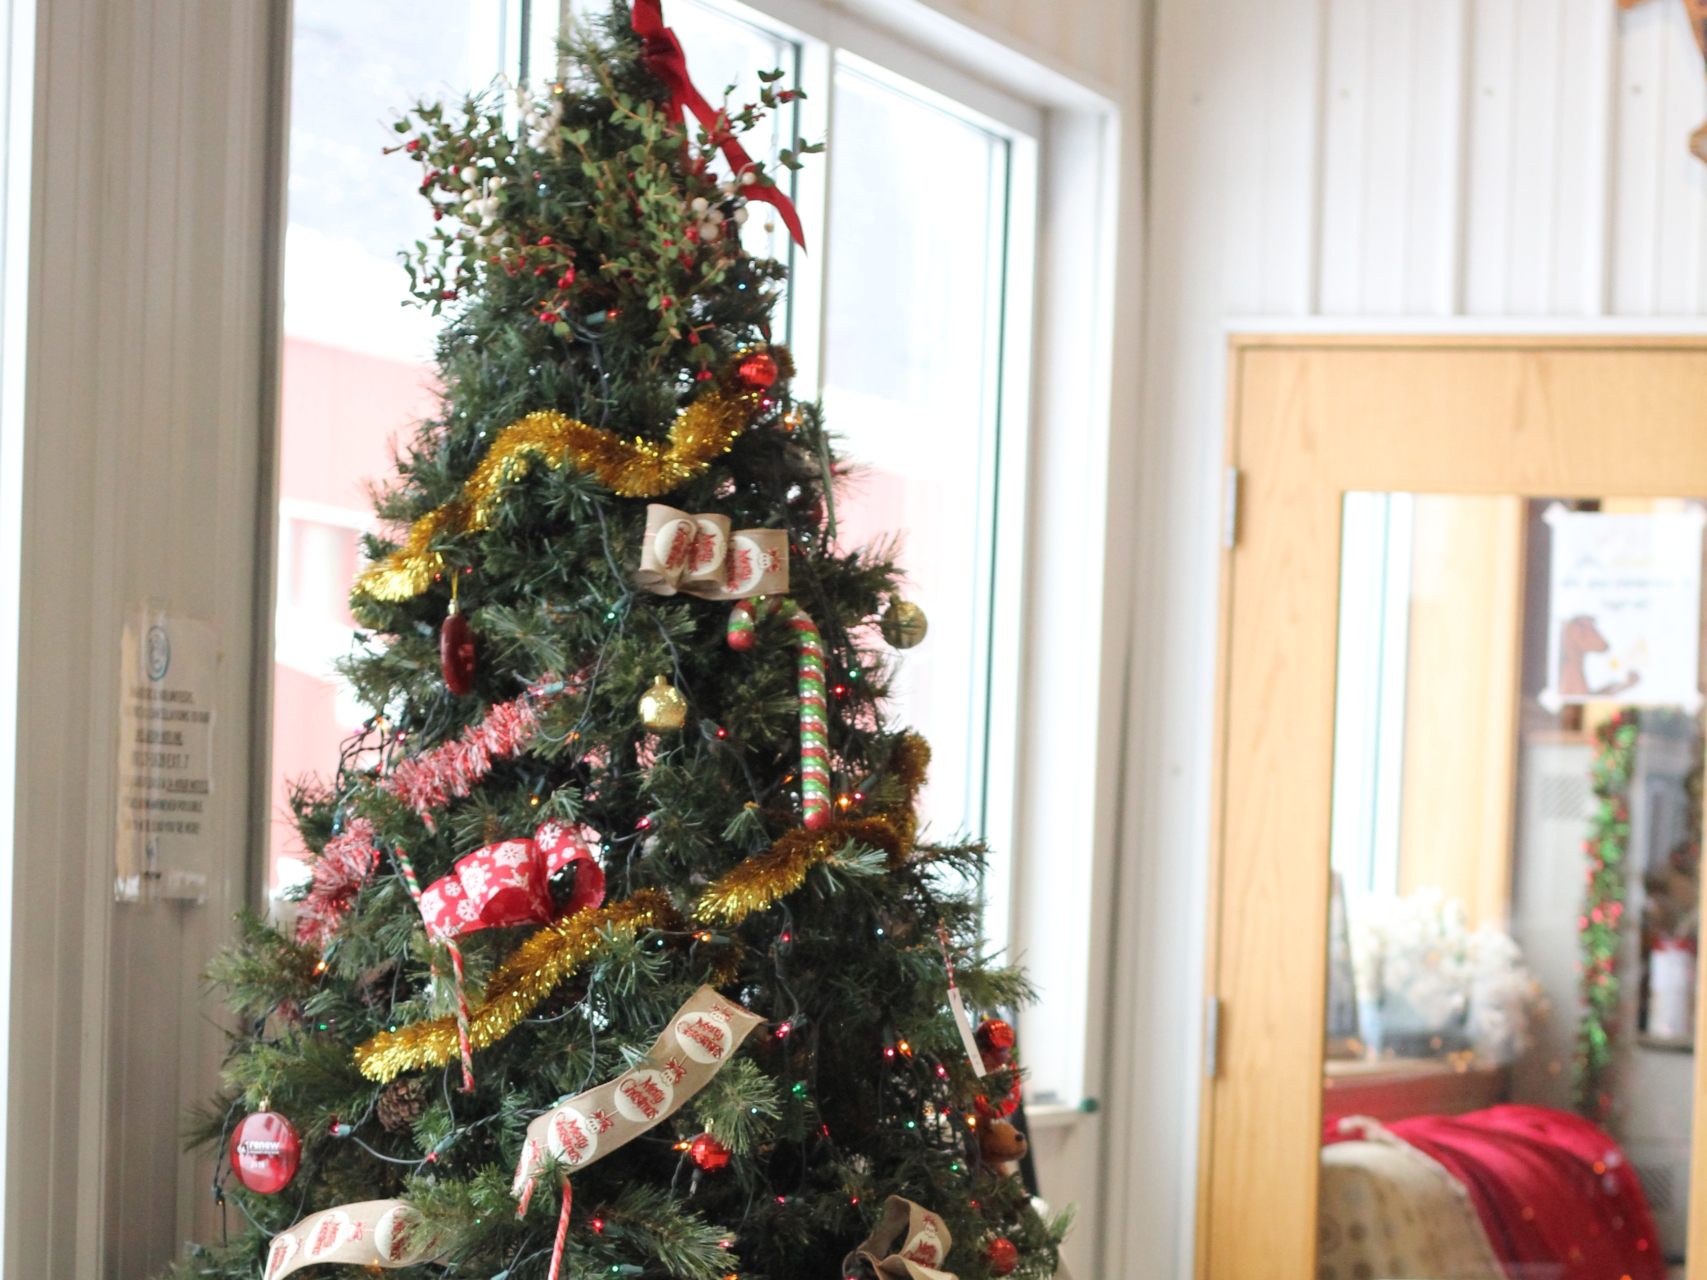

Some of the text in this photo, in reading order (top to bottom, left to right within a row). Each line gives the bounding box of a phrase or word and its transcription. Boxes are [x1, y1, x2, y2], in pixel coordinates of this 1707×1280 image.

[676, 1020, 724, 1060] Christmas
[695, 1016, 724, 1042] Merry
[619, 1078, 659, 1121] Christmas
[638, 1075, 666, 1105] Merry
[249, 1140, 280, 1149] renew
[555, 1111, 583, 1165] Christmas
[566, 1118, 590, 1150] Merry
